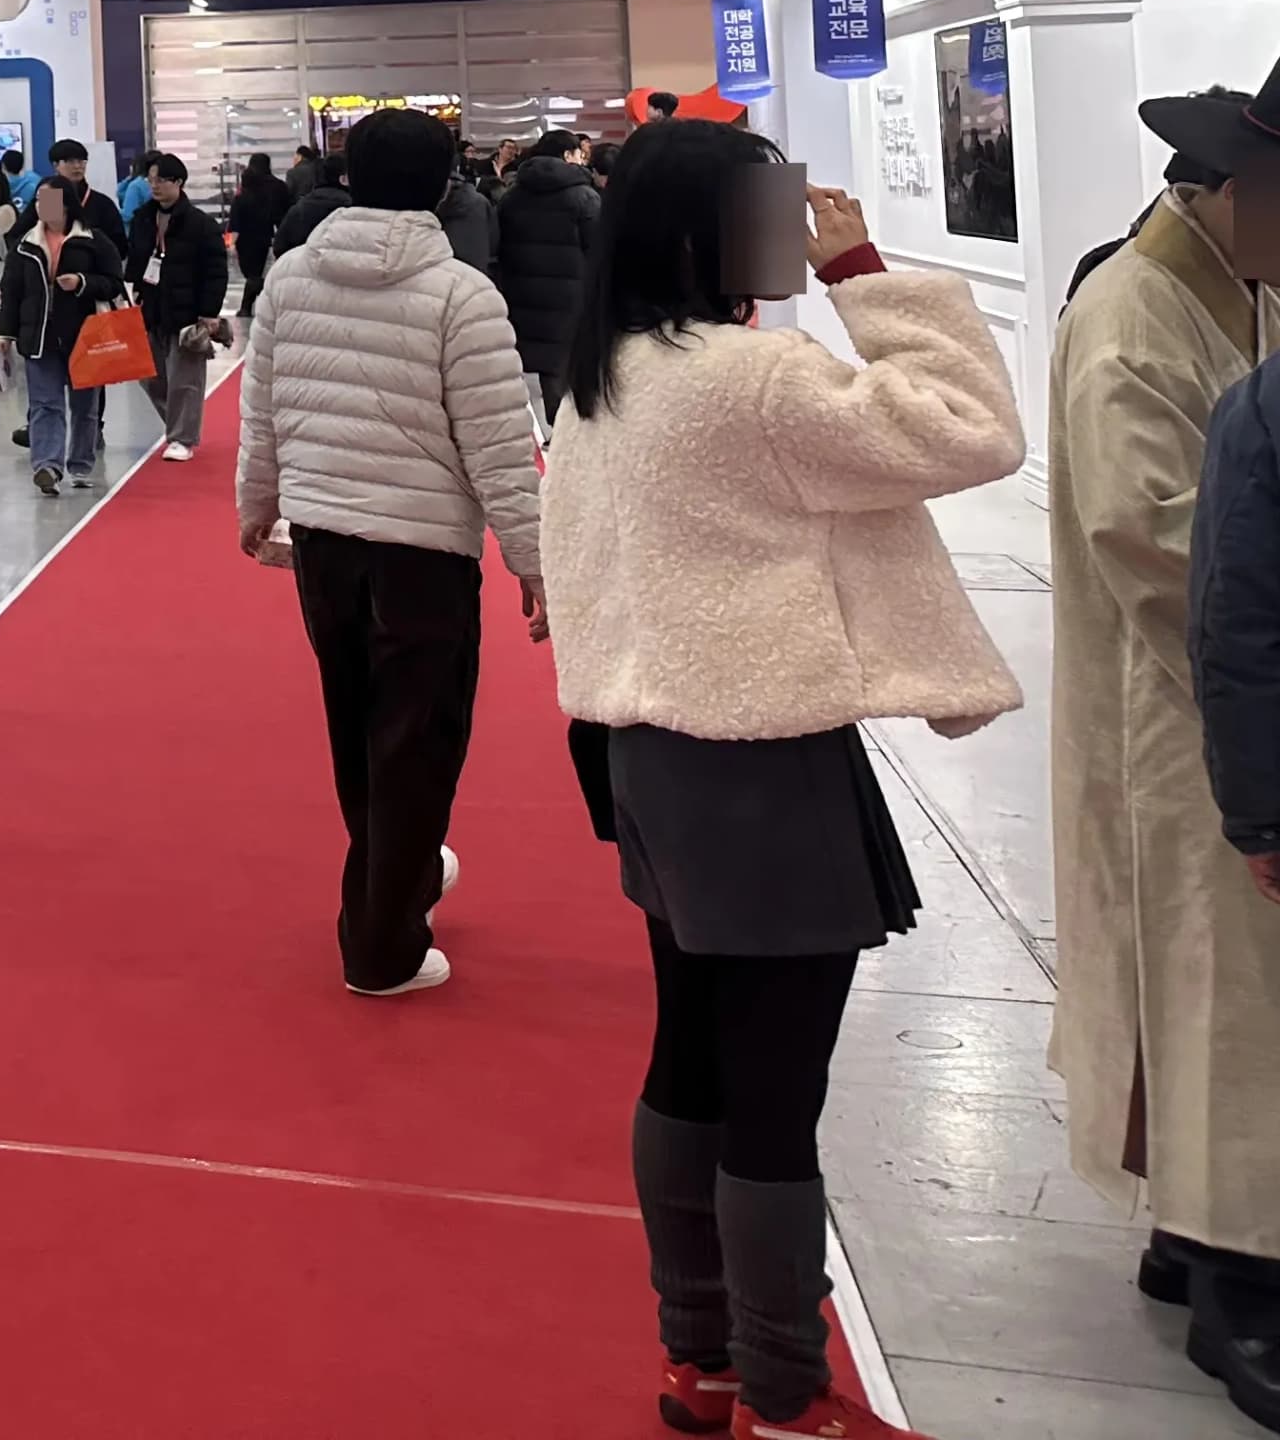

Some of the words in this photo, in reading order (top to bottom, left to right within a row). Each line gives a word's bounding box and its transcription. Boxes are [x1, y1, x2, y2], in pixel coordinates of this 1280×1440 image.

[723, 9, 753, 24] 대학
[724, 25, 754, 41] 전공
[828, 19, 869, 40] 전문
[726, 41, 755, 57] 수업
[727, 58, 757, 73] 지원
